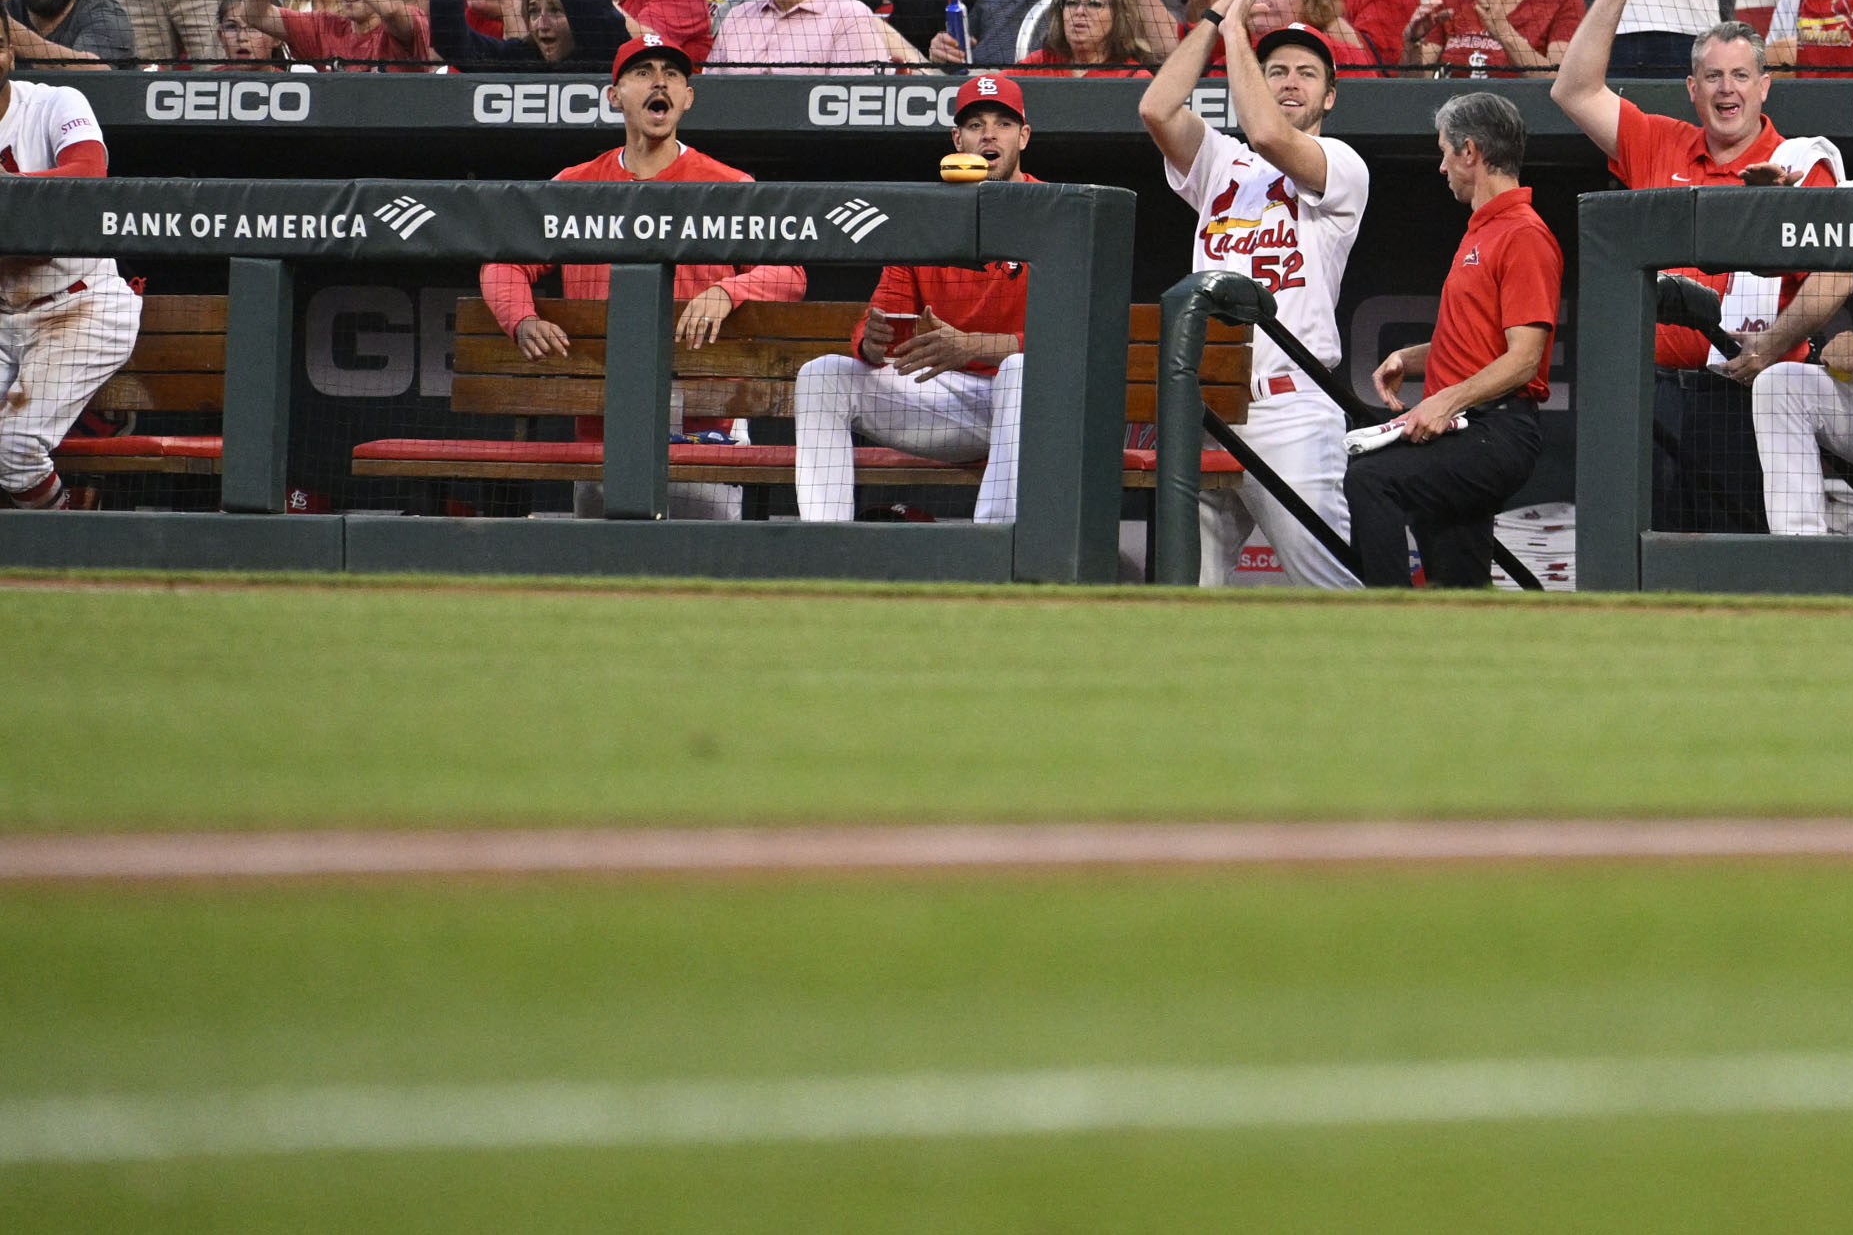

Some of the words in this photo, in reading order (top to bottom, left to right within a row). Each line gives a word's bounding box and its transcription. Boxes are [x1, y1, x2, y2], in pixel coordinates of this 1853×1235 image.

[146, 81, 310, 121] GEICO
[103, 212, 181, 237] BANK
[191, 214, 227, 238] OF
[234, 214, 367, 239] AMERICA
[544, 215, 625, 240] BANK
[634, 215, 673, 240] OF
[681, 215, 819, 241] AMERICA
[1251, 250, 1306, 294] 52
